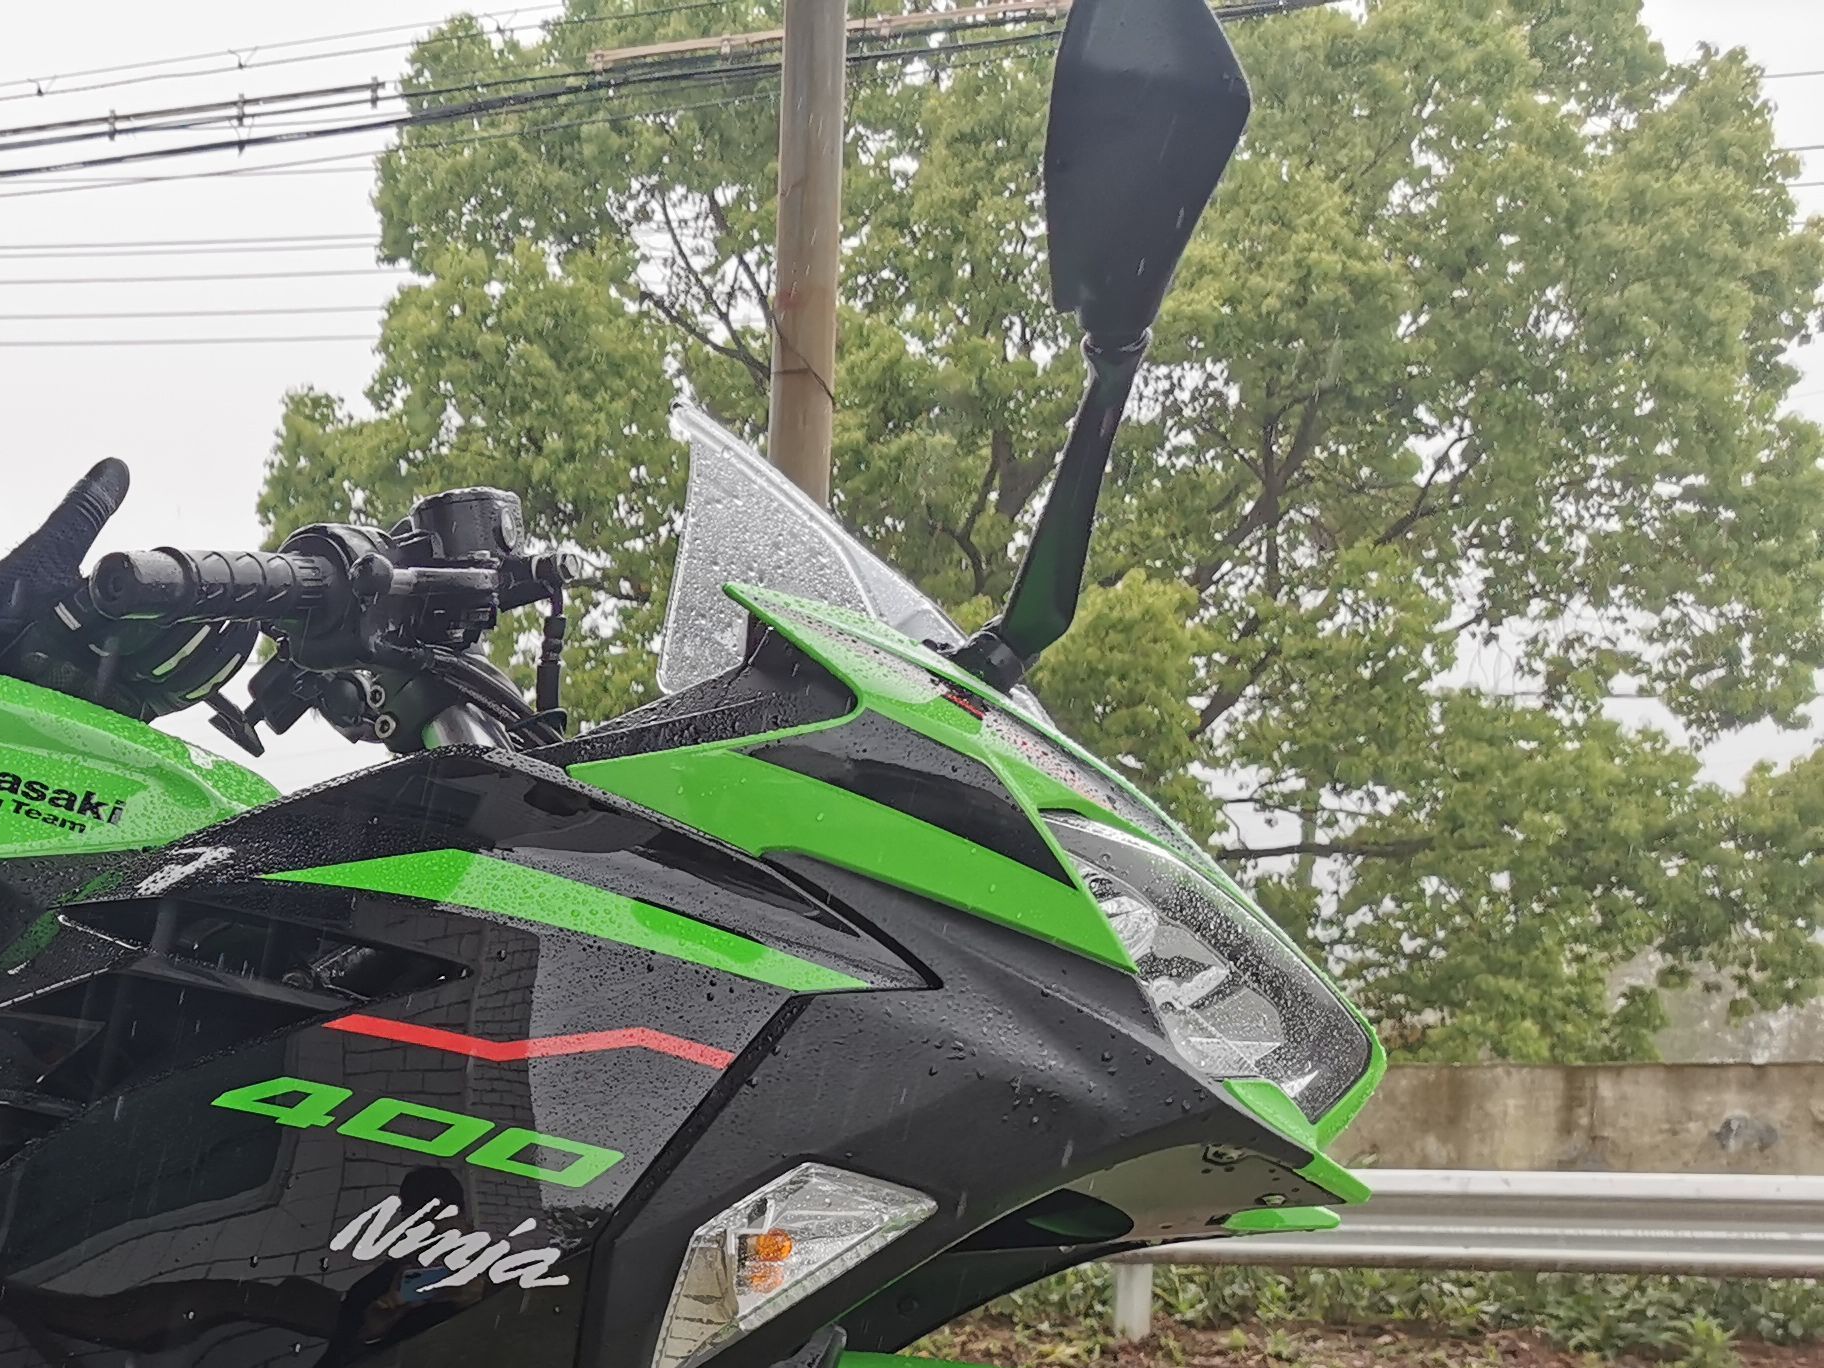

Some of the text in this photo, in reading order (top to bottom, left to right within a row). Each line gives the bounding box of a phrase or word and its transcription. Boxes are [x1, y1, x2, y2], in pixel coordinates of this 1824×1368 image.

[12, 799, 88, 834] Team
[211, 1076, 625, 1188] 400
[329, 1195, 570, 1293] Ninja
